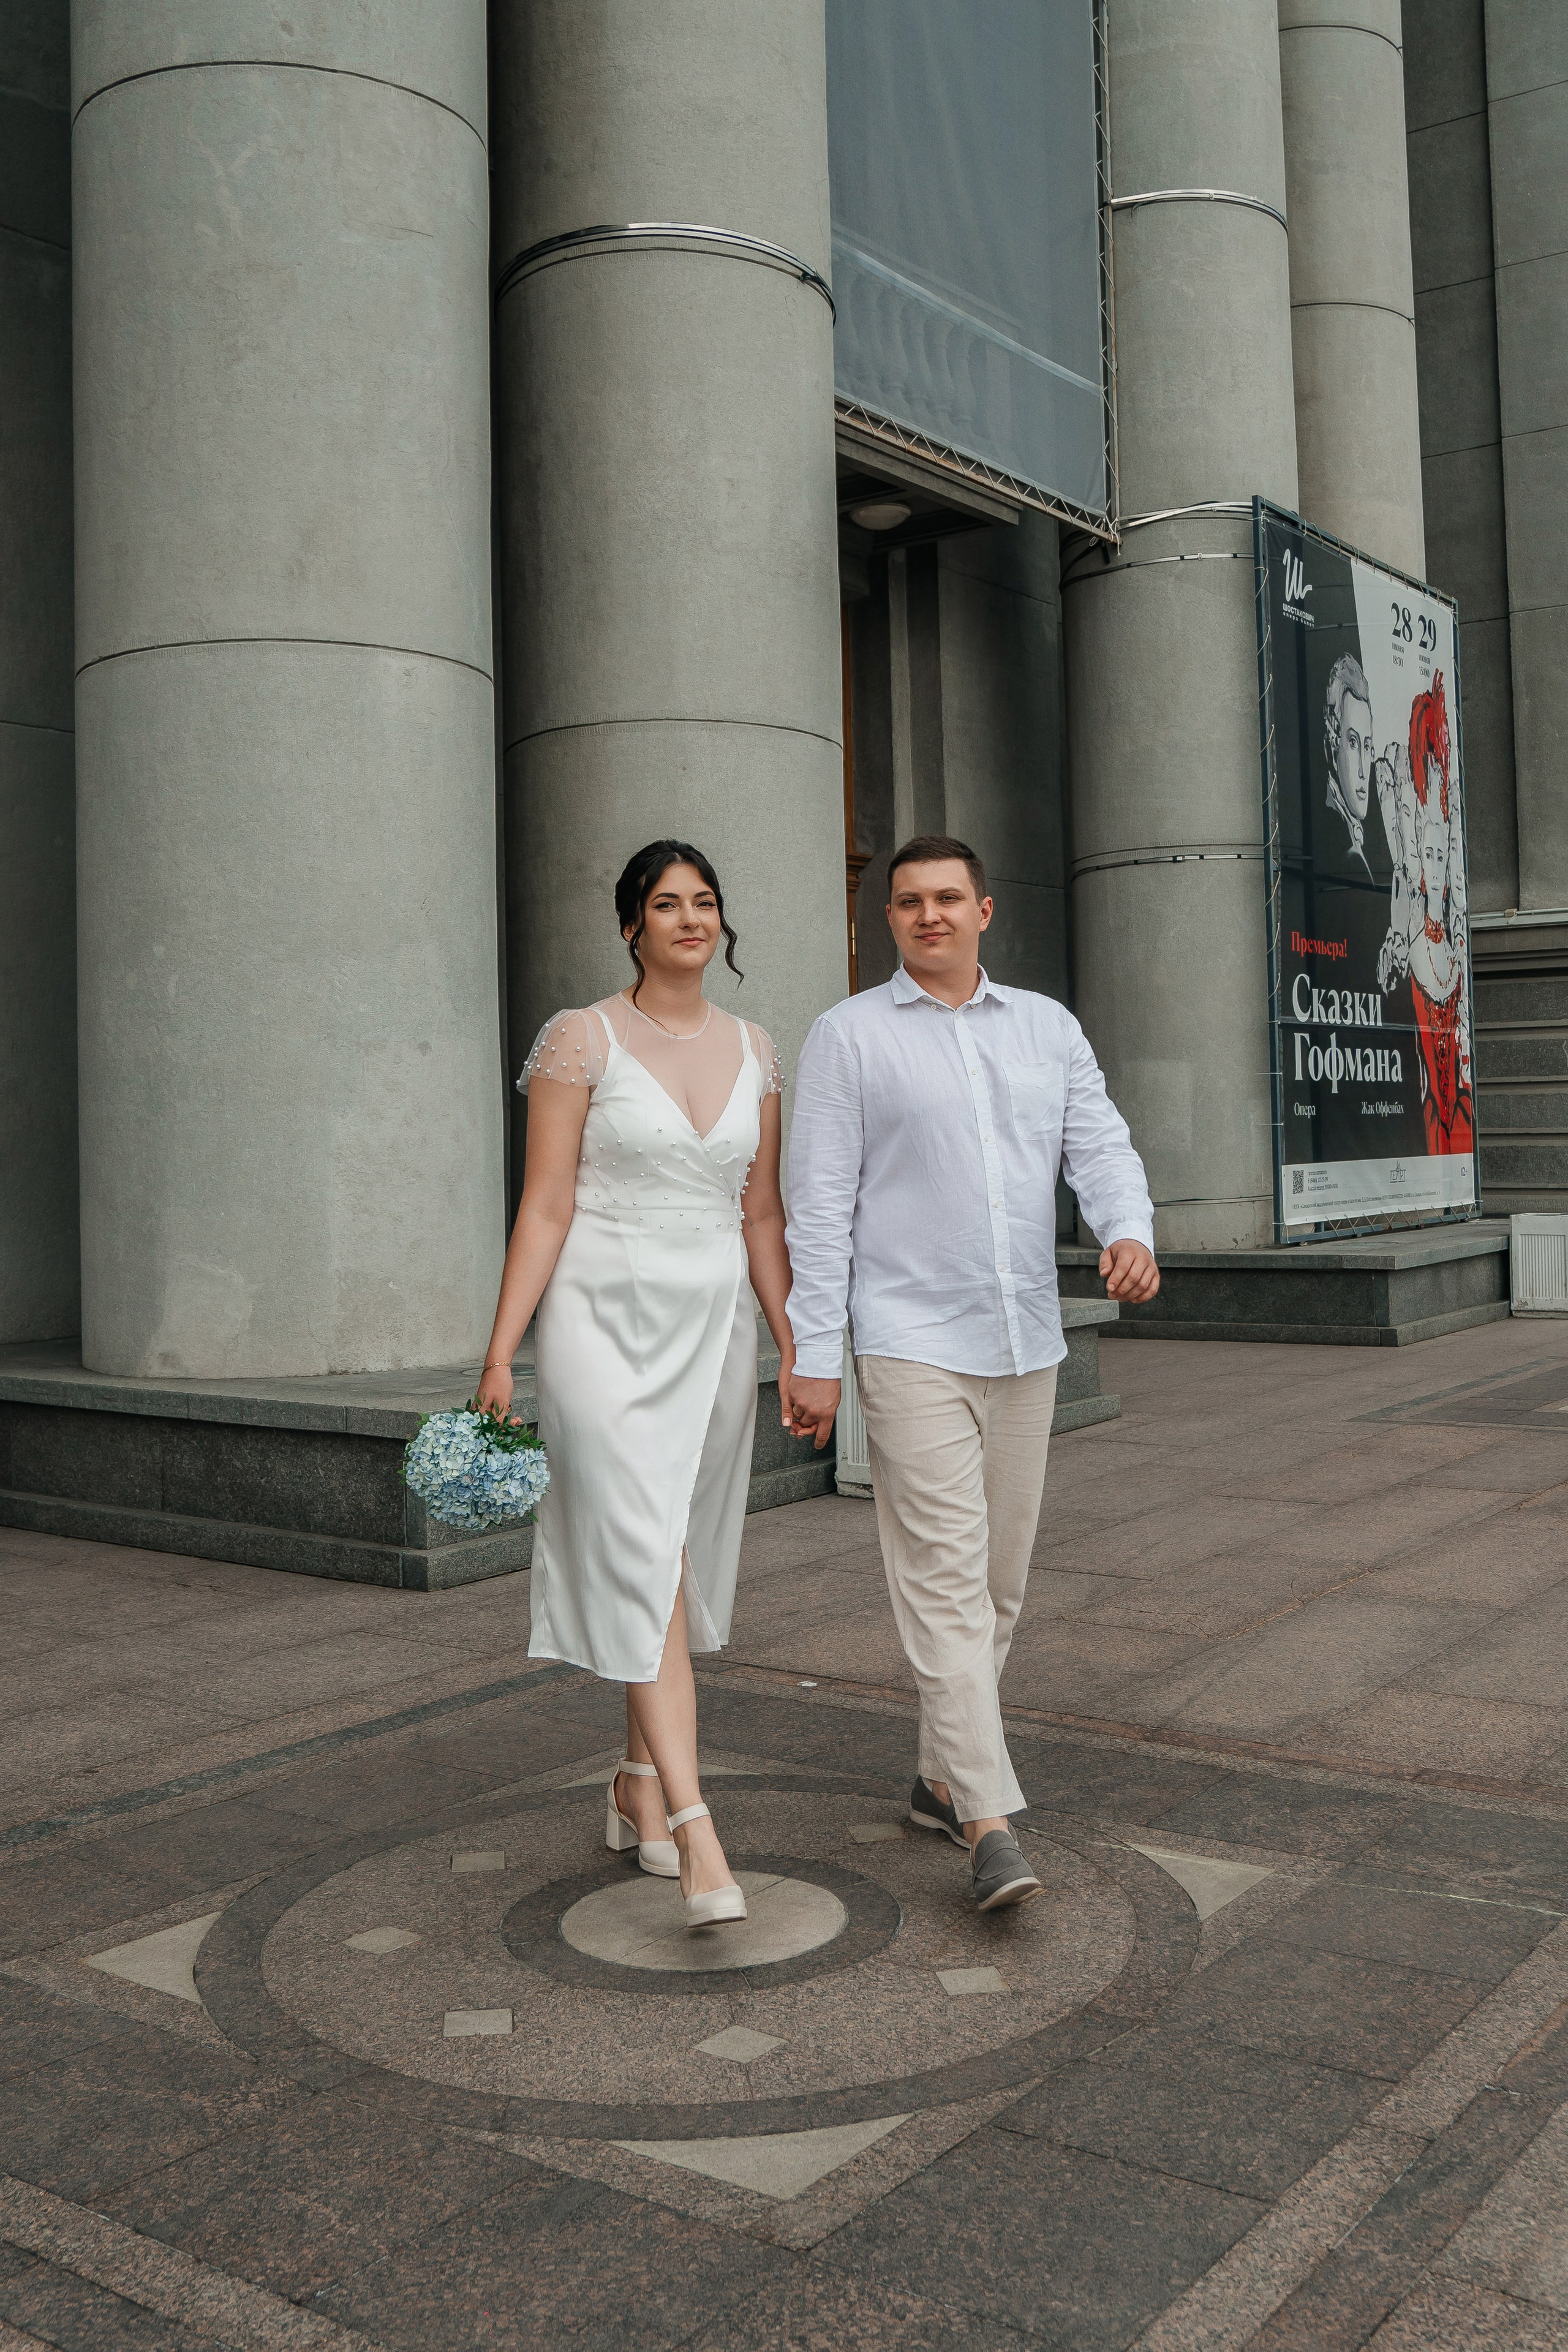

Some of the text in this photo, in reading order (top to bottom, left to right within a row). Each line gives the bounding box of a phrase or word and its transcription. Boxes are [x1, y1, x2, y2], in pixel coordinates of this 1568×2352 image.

[1283, 603, 1314, 623] ШОСТАКОВИЧ
[1283, 611, 1298, 622] опера
[1391, 602, 1436, 652] 28 29
[1392, 655, 1404, 668] 18:30
[1419, 666, 1430, 678] 15:00
[1292, 932, 1347, 961] Премьера!
[1292, 973, 1382, 1027] Сказки
[1294, 1031, 1403, 1093] Гофмана
[1294, 1102, 1316, 1118] Опера
[1362, 1101, 1404, 1117] Жак Оффенбах
